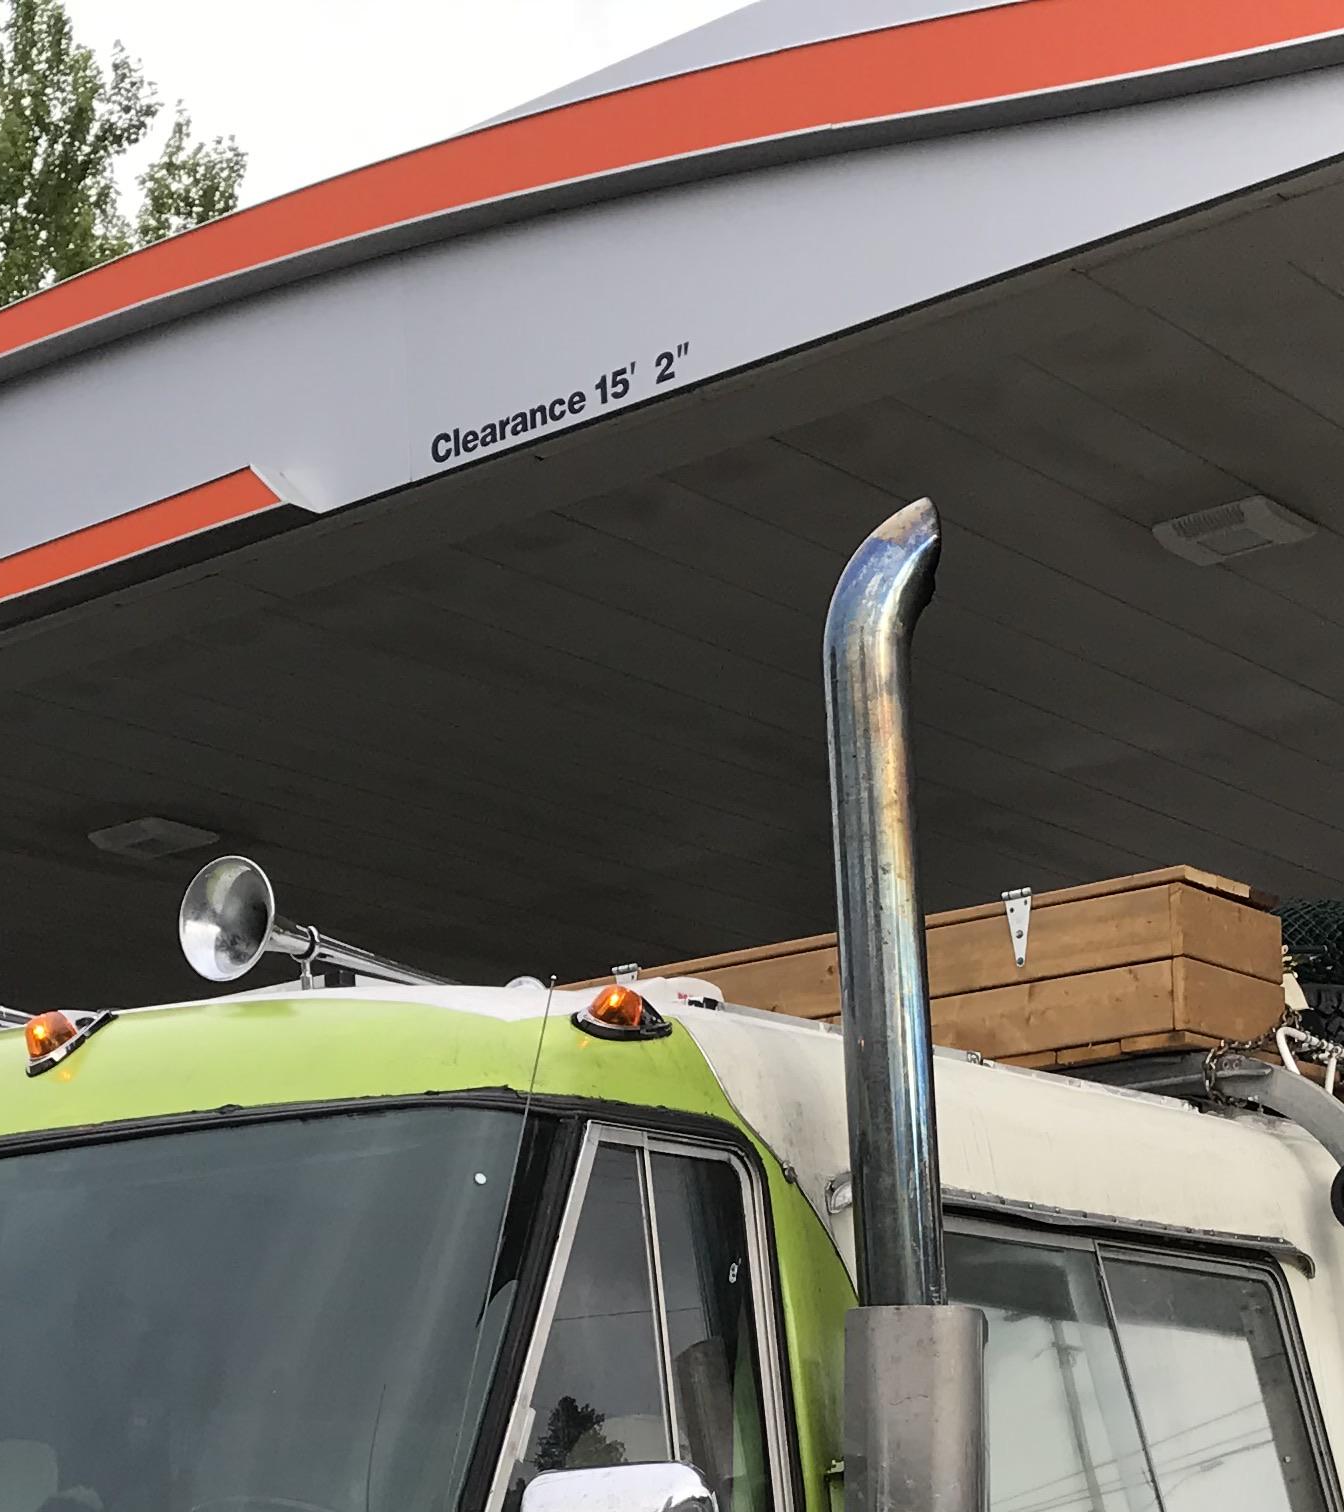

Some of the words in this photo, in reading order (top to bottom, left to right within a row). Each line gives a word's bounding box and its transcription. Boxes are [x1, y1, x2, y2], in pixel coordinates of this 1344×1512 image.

[431, 390, 586, 463] Clearance
[594, 361, 636, 404] 15'
[655, 341, 689, 385] 2"
